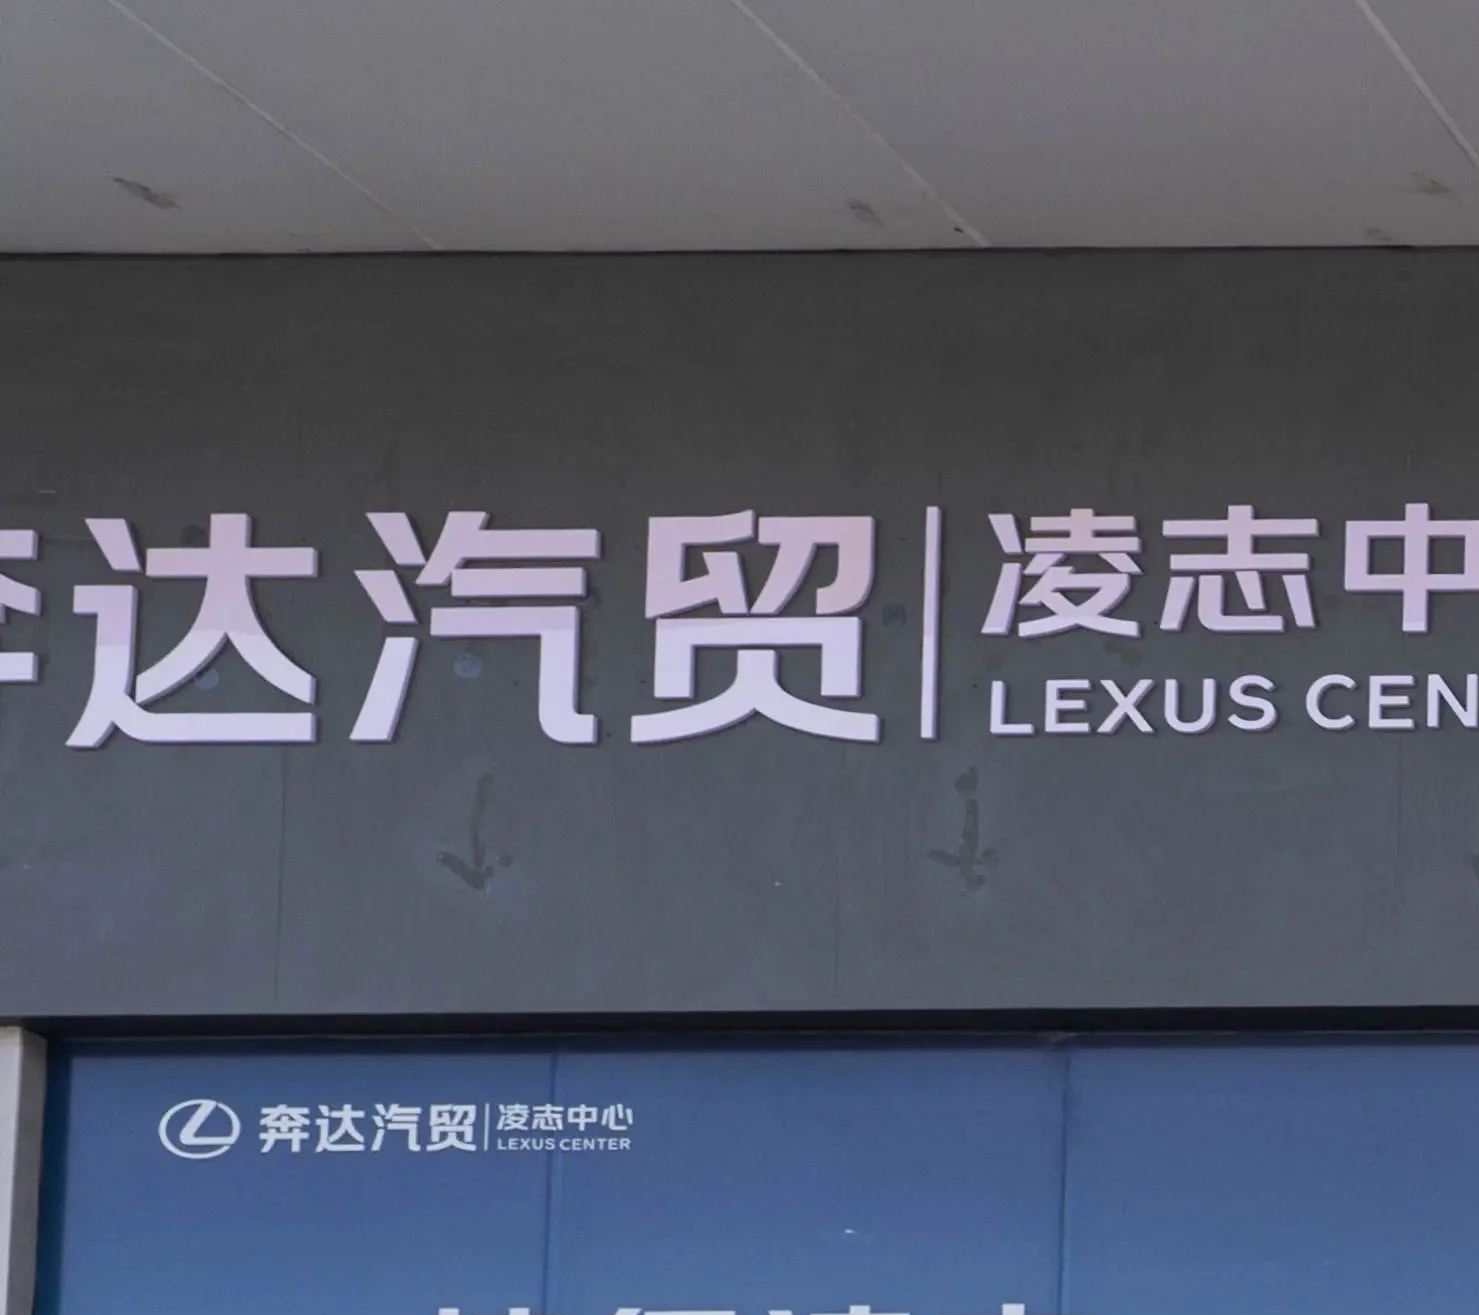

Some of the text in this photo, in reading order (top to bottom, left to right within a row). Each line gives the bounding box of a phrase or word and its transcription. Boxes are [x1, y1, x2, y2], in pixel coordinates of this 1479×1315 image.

[0, 509, 880, 748] 达汽贸
[989, 674, 1279, 735] LEXUS
[259, 1103, 477, 1153] 奔达汽贸
[496, 1103, 634, 1131] 凌志中心
[497, 1137, 632, 1151] LEXUS CENTER
